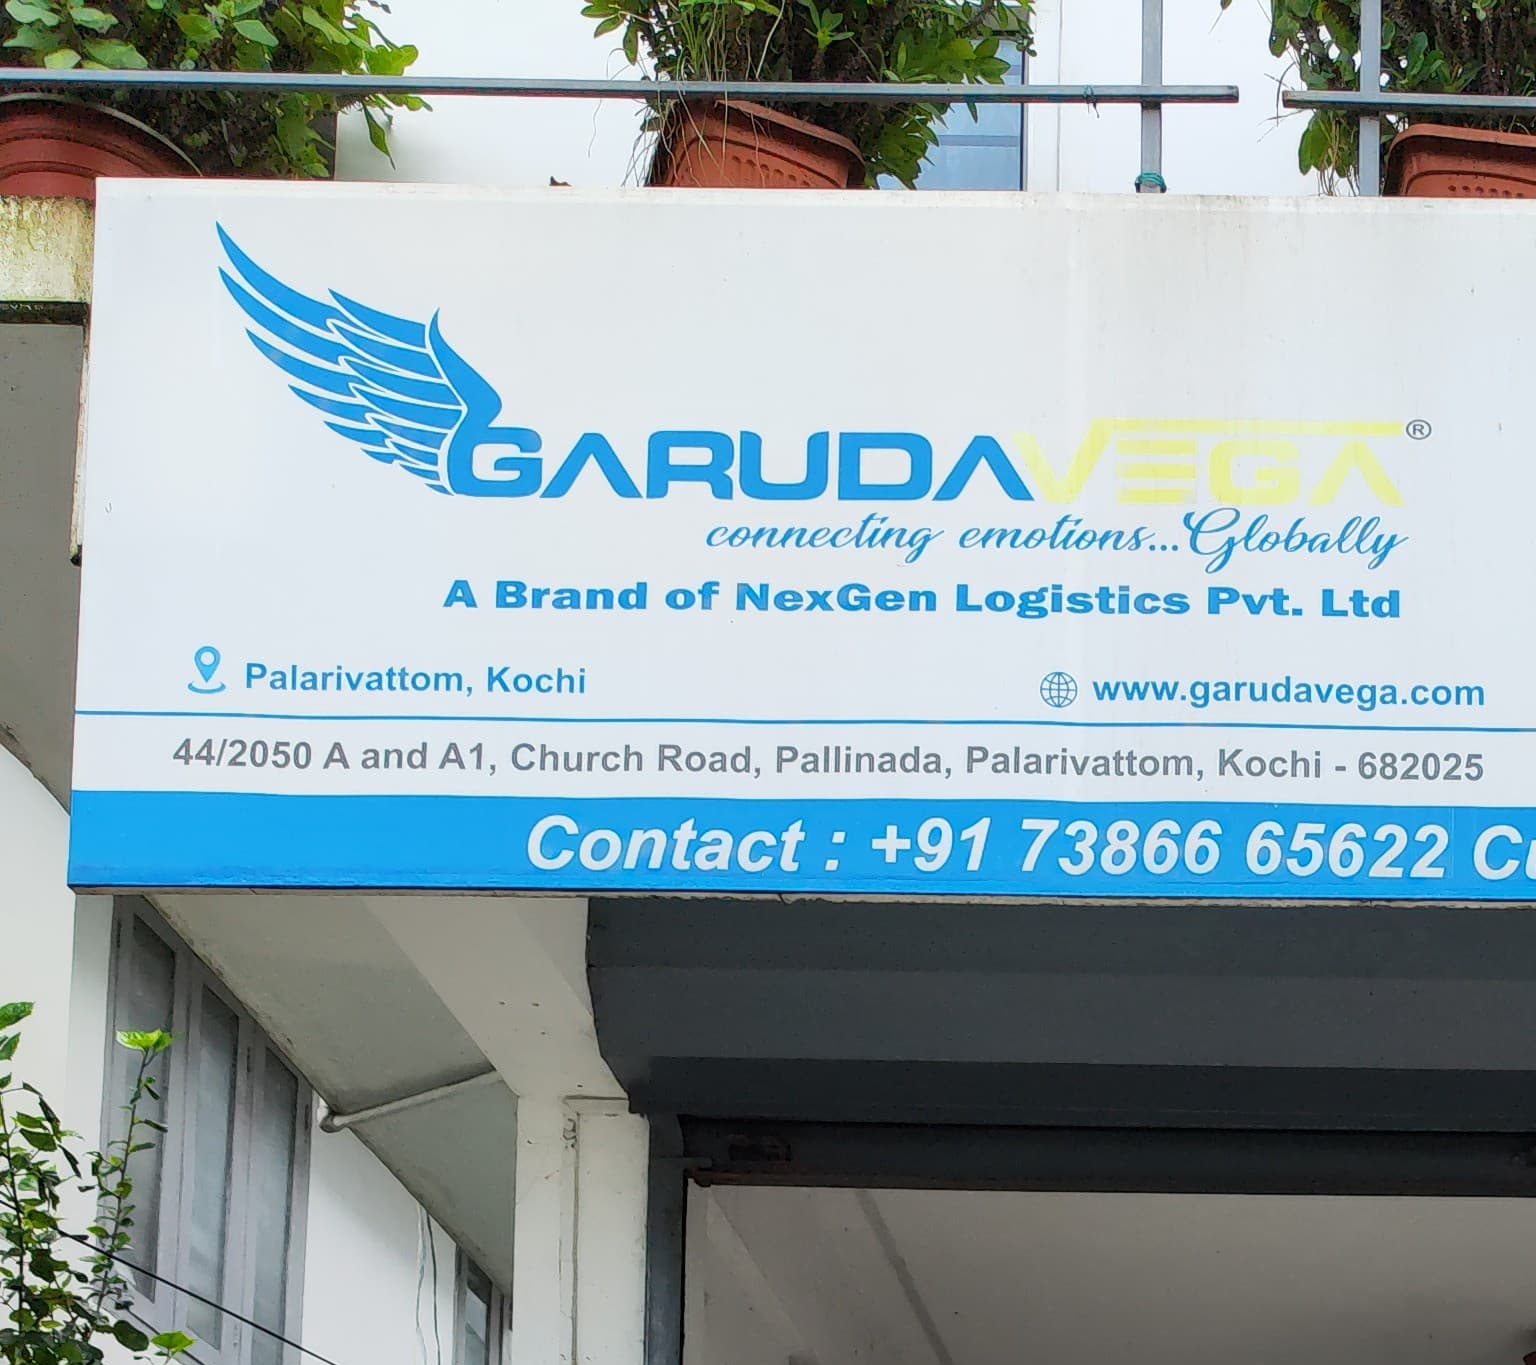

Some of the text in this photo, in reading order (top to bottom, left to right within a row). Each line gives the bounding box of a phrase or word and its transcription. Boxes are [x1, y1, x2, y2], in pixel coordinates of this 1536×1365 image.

[446, 418, 1404, 507] GARUDAVEGA
[706, 511, 944, 564] connecting
[444, 580, 1401, 620] A Brand of NexGen Logistics Pvt. Ltd
[246, 663, 586, 695] Palarivattom, Kochi
[1094, 677, 1485, 713] www.garudavega.com
[174, 740, 312, 770] 44/2050
[325, 744, 350, 769] A
[363, 744, 428, 770] and
[440, 744, 496, 775] A1,
[513, 745, 643, 772] Church
[660, 746, 761, 779] Road,
[778, 747, 952, 779] Pallinada,
[968, 748, 1204, 779] Palarivattom,
[1220, 750, 1321, 778] Kochi
[1356, 752, 1486, 781] 682025
[527, 815, 804, 873] Contact
[871, 816, 992, 873] +91
[1019, 818, 1221, 876] 73866
[1244, 821, 1450, 878] 65622
